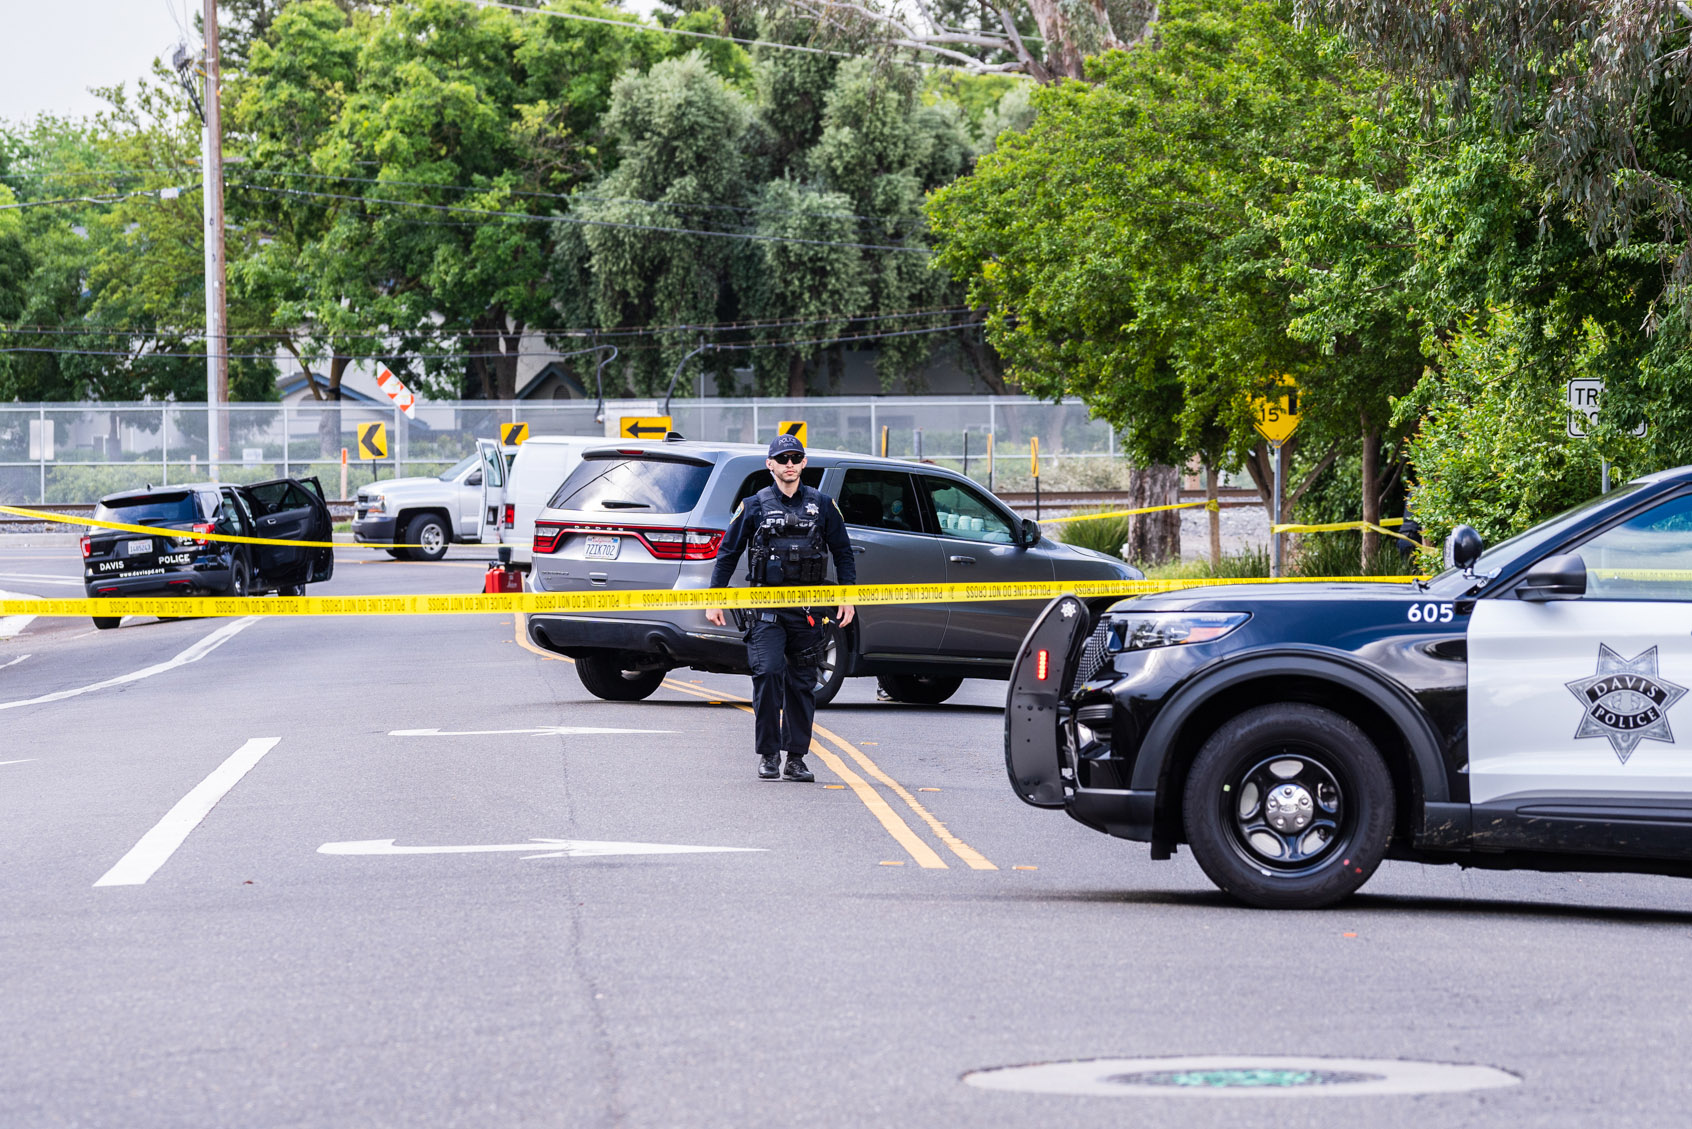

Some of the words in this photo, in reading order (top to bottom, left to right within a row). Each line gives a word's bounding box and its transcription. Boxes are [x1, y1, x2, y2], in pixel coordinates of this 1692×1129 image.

[158, 554, 190, 565] POLICE
[99, 561, 125, 572] DAVIS
[895, 587, 905, 601] DO
[906, 587, 920, 600] LINE
[921, 586, 943, 600] POLICE
[966, 585, 986, 598] CROSS
[989, 585, 1002, 598] NOT
[1003, 585, 1013, 598] DO
[1014, 584, 1028, 597] LINE
[1029, 584, 1051, 597] POLICE
[1074, 583, 1095, 595] CROSS
[1097, 582, 1110, 594] NOT
[1111, 582, 1121, 594] DO
[1122, 582, 1136, 594] LINE
[1137, 581, 1159, 594] POLICE
[598, 595, 619, 607] POLICE
[643, 594, 663, 606] CROSS
[665, 593, 678, 606] NOT
[679, 593, 689, 606] DO
[690, 593, 704, 606] LINE
[705, 592, 727, 605] POLICE
[750, 591, 771, 604] CROSS
[773, 590, 786, 604] NOT
[787, 590, 797, 603] DO
[798, 590, 812, 603] LINE
[813, 590, 835, 603] POLICE
[858, 588, 879, 602] CROSS
[881, 588, 894, 601] NOT
[216, 601, 236, 613] CROSS
[238, 601, 250, 613] NOT
[251, 601, 261, 613] DO
[262, 601, 276, 612] LINE
[277, 600, 298, 612] POLICE
[535, 596, 556, 608] CROSS
[558, 596, 571, 608] NOT
[572, 595, 582, 608] DO
[583, 595, 597, 608] LINE
[1408, 603, 1454, 623] 605
[1593, 676, 1659, 698] DAVIS
[1595, 707, 1657, 728] POLICE
